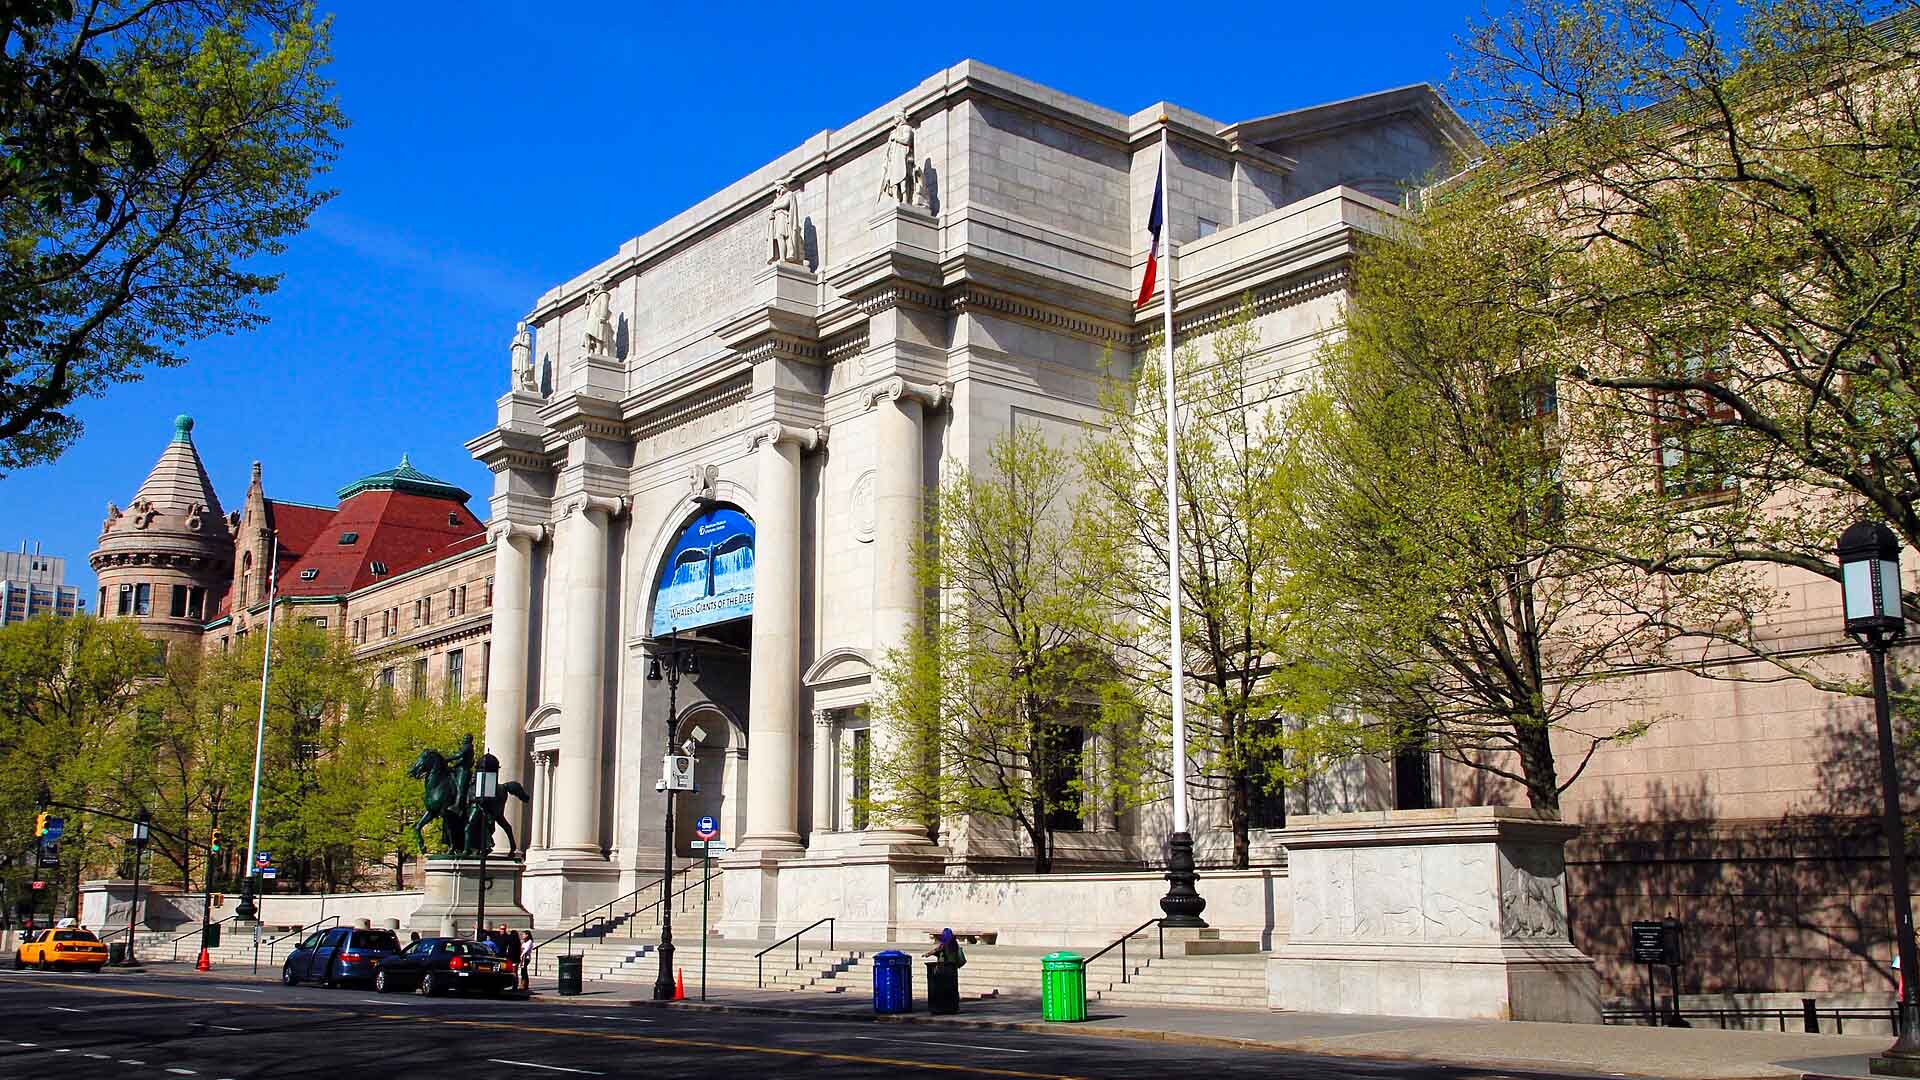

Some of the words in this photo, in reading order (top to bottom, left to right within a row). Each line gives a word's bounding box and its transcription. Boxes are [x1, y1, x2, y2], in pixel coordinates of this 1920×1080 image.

[695, 601, 717, 613] GIANTS
[717, 599, 726, 609] OF
[727, 596, 738, 606] THE
